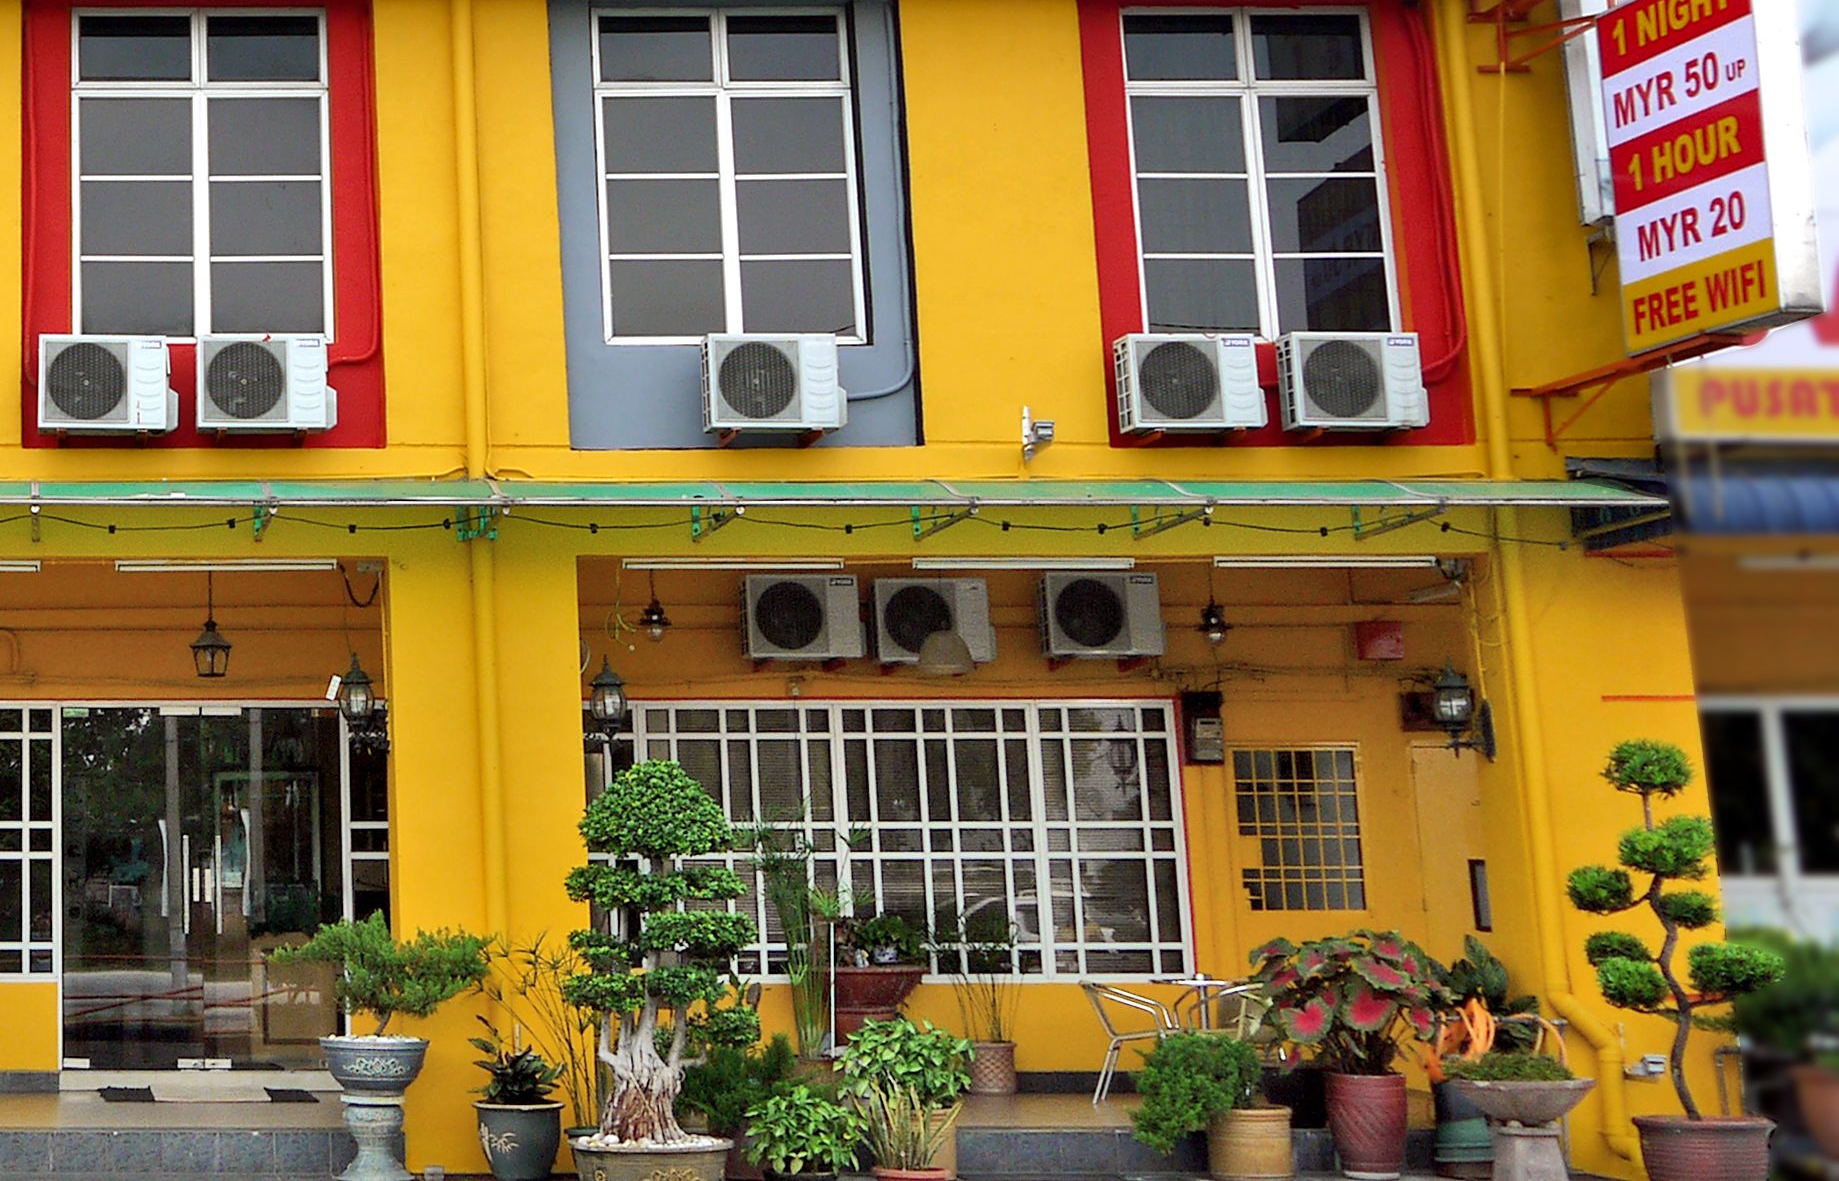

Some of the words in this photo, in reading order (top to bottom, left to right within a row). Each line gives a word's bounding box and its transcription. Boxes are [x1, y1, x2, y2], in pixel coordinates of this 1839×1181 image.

[1611, 16, 1626, 57] 1
[1613, 71, 1677, 129] MYR
[1685, 51, 1720, 98] 50
[1726, 58, 1747, 82] UP
[1628, 152, 1643, 192] 1
[1653, 115, 1742, 184] HOUR
[1638, 203, 1702, 262] MYR
[1711, 190, 1746, 238] 20
[1633, 281, 1699, 335] FREE
[1705, 259, 1767, 313] WIFI
